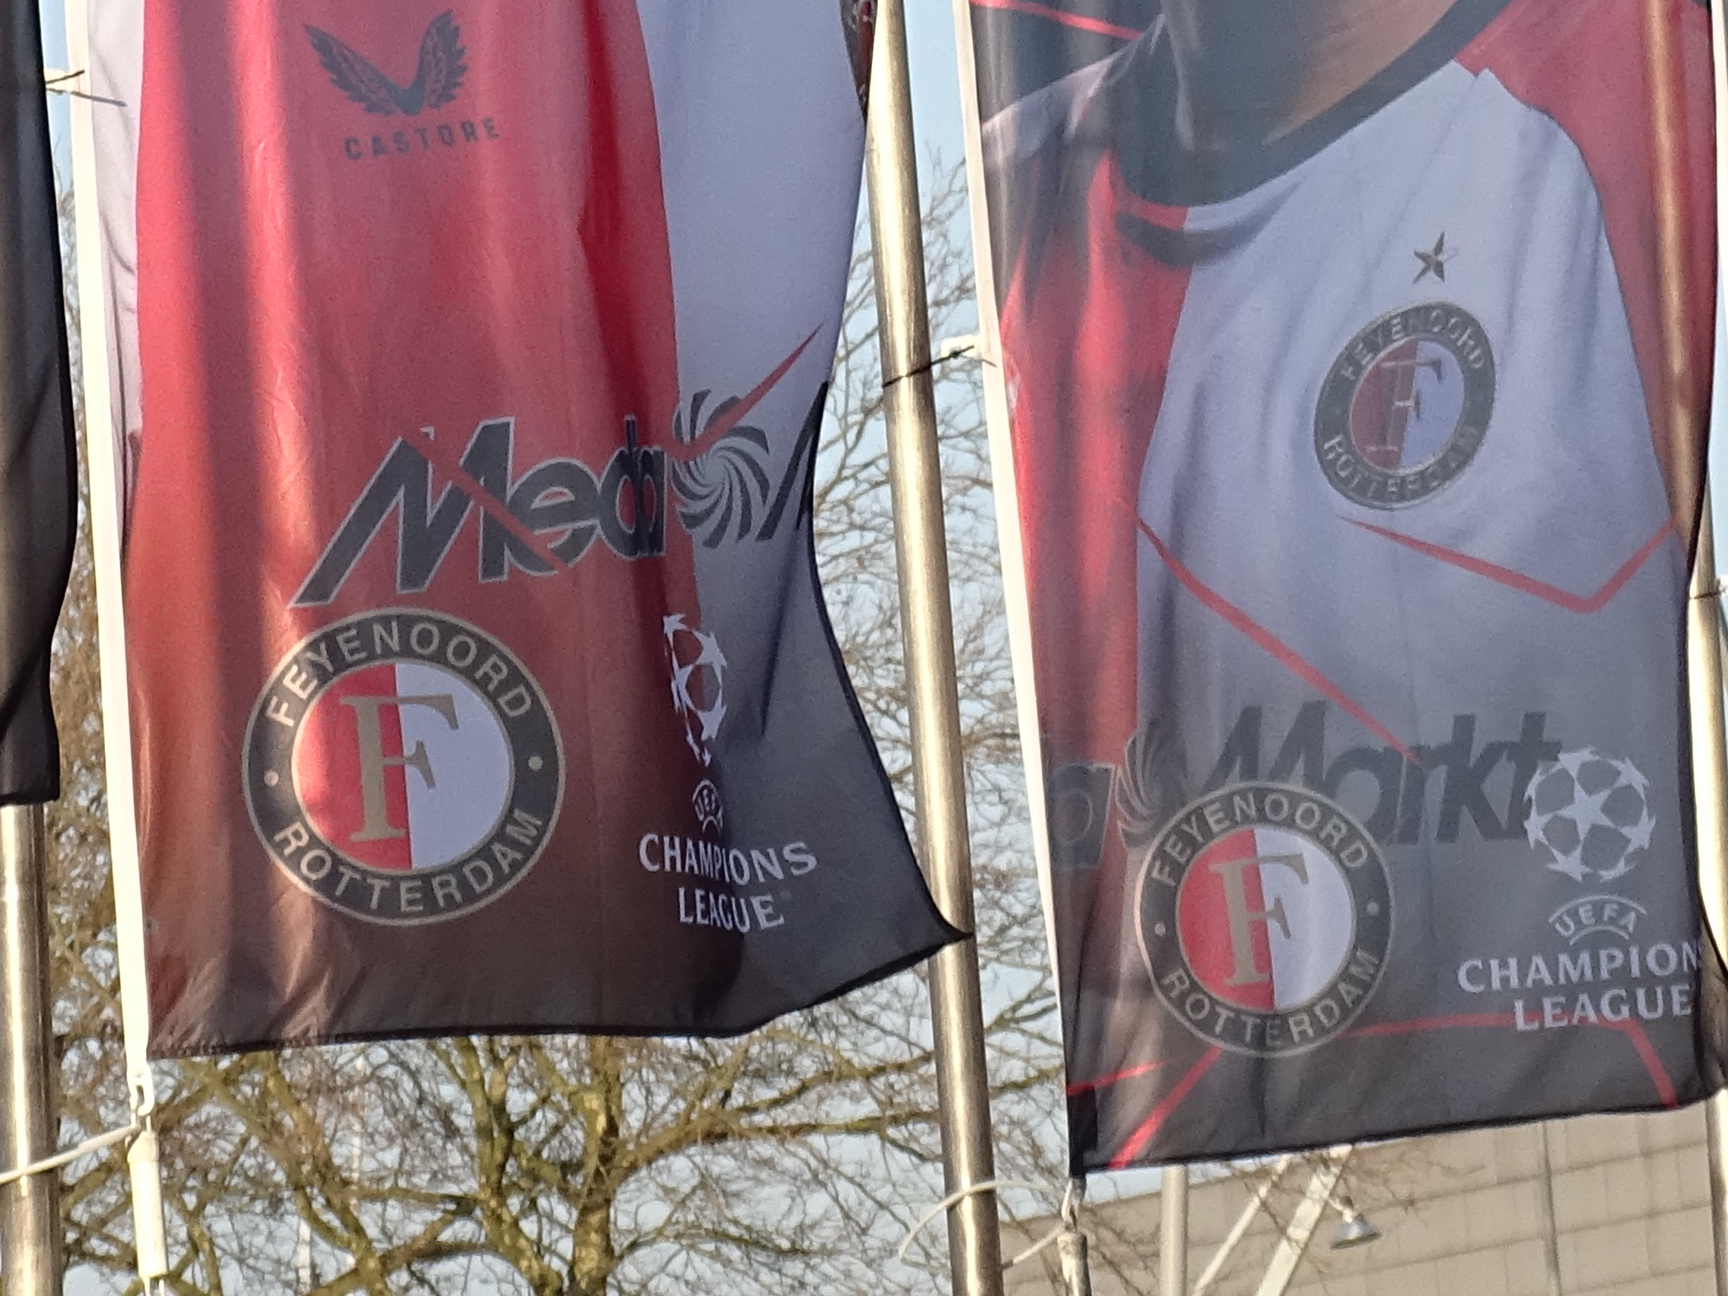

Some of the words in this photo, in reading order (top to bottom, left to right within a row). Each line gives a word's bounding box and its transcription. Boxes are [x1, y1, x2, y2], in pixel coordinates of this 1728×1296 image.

[265, 620, 532, 727] FEYENOORD
[339, 694, 459, 841] F
[274, 808, 542, 912] ROTTERDAM
[639, 833, 818, 886] CHAMPIONS
[1151, 792, 1368, 887] FEYENOORD
[678, 886, 785, 933] LEAGUE
[1209, 852, 1309, 986] F
[1554, 903, 1638, 938] UEFA
[1162, 948, 1380, 1044] ROTTERDAM
[1457, 940, 1700, 994] CHAMPION
[1513, 983, 1693, 1032] LEAGUE
